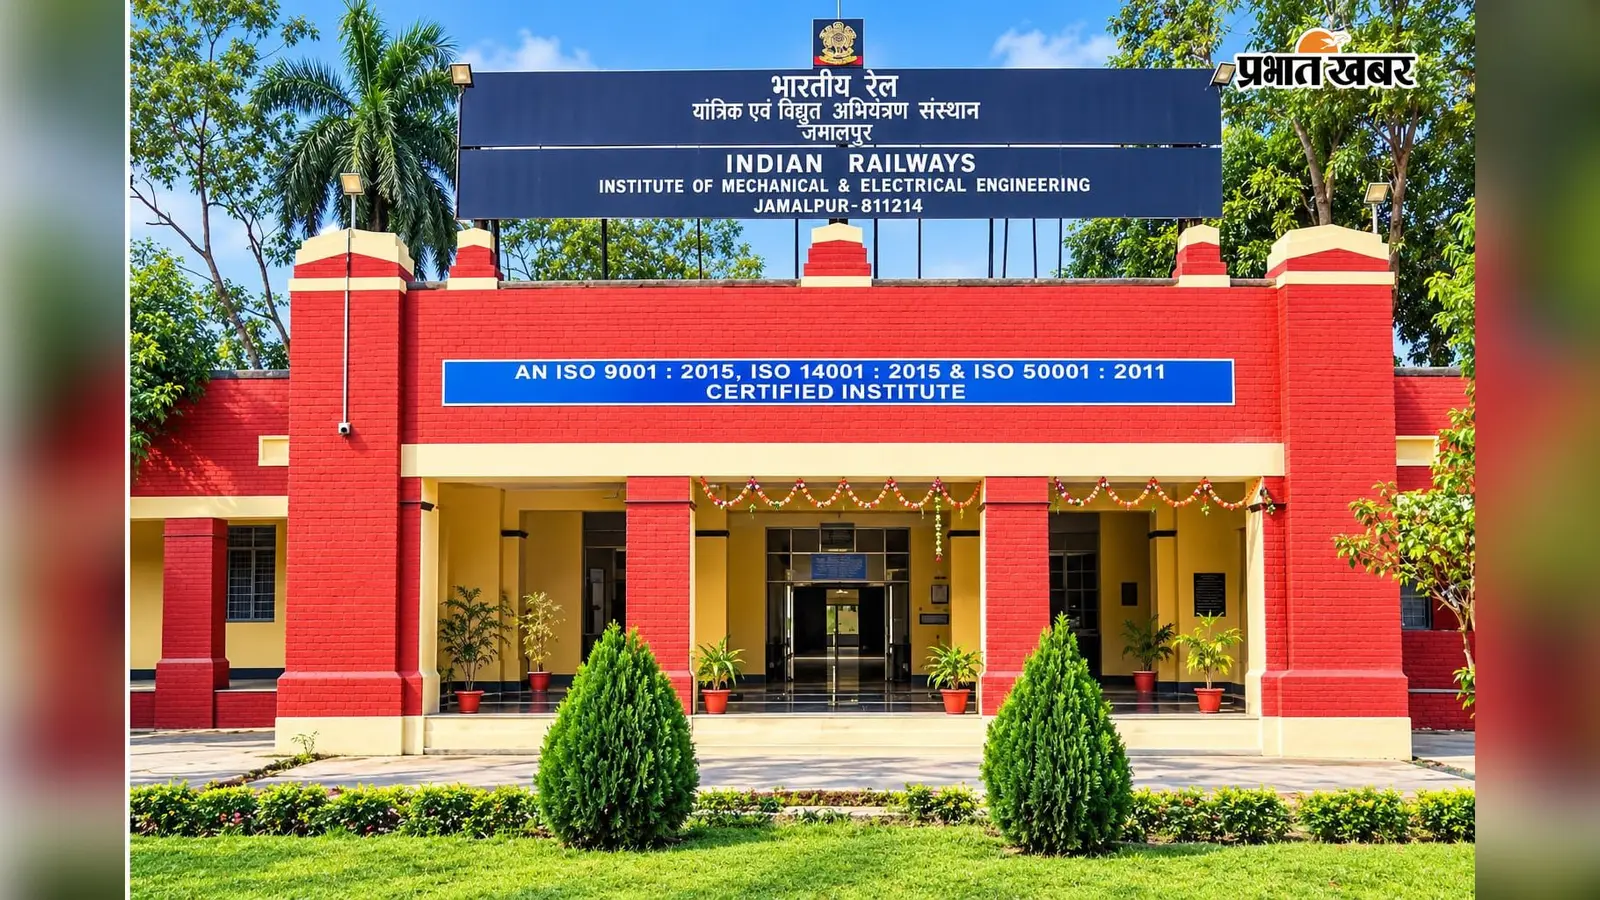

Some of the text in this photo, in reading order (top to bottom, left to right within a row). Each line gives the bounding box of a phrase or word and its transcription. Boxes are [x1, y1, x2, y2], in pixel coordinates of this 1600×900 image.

[771, 69, 899, 98] भारतीय रेल
[692, 97, 981, 125] यांत्रिक एवं विद्युत अभियंत्रण संस्थान
[797, 124, 873, 145] जमालपुर
[726, 153, 976, 174] INDIAN RAILWAYS
[599, 177, 1090, 194] INSTITUTE OF MECHANICAL & ELECTRICAL ENGINEERING
[515, 364, 547, 380] AN
[556, 364, 596, 380] ISO
[604, 364, 656, 380] 9001
[681, 364, 741, 382] 2015,
[751, 363, 791, 380] ISO
[800, 363, 863, 379] 14001
[888, 363, 941, 379] 2015
[949, 363, 965, 379] &
[974, 363, 1014, 379] ISO
[1023, 363, 1089, 379] 50001
[1114, 363, 1164, 379] 2011
[706, 383, 966, 400] CERTIFIED INSTITUTE
